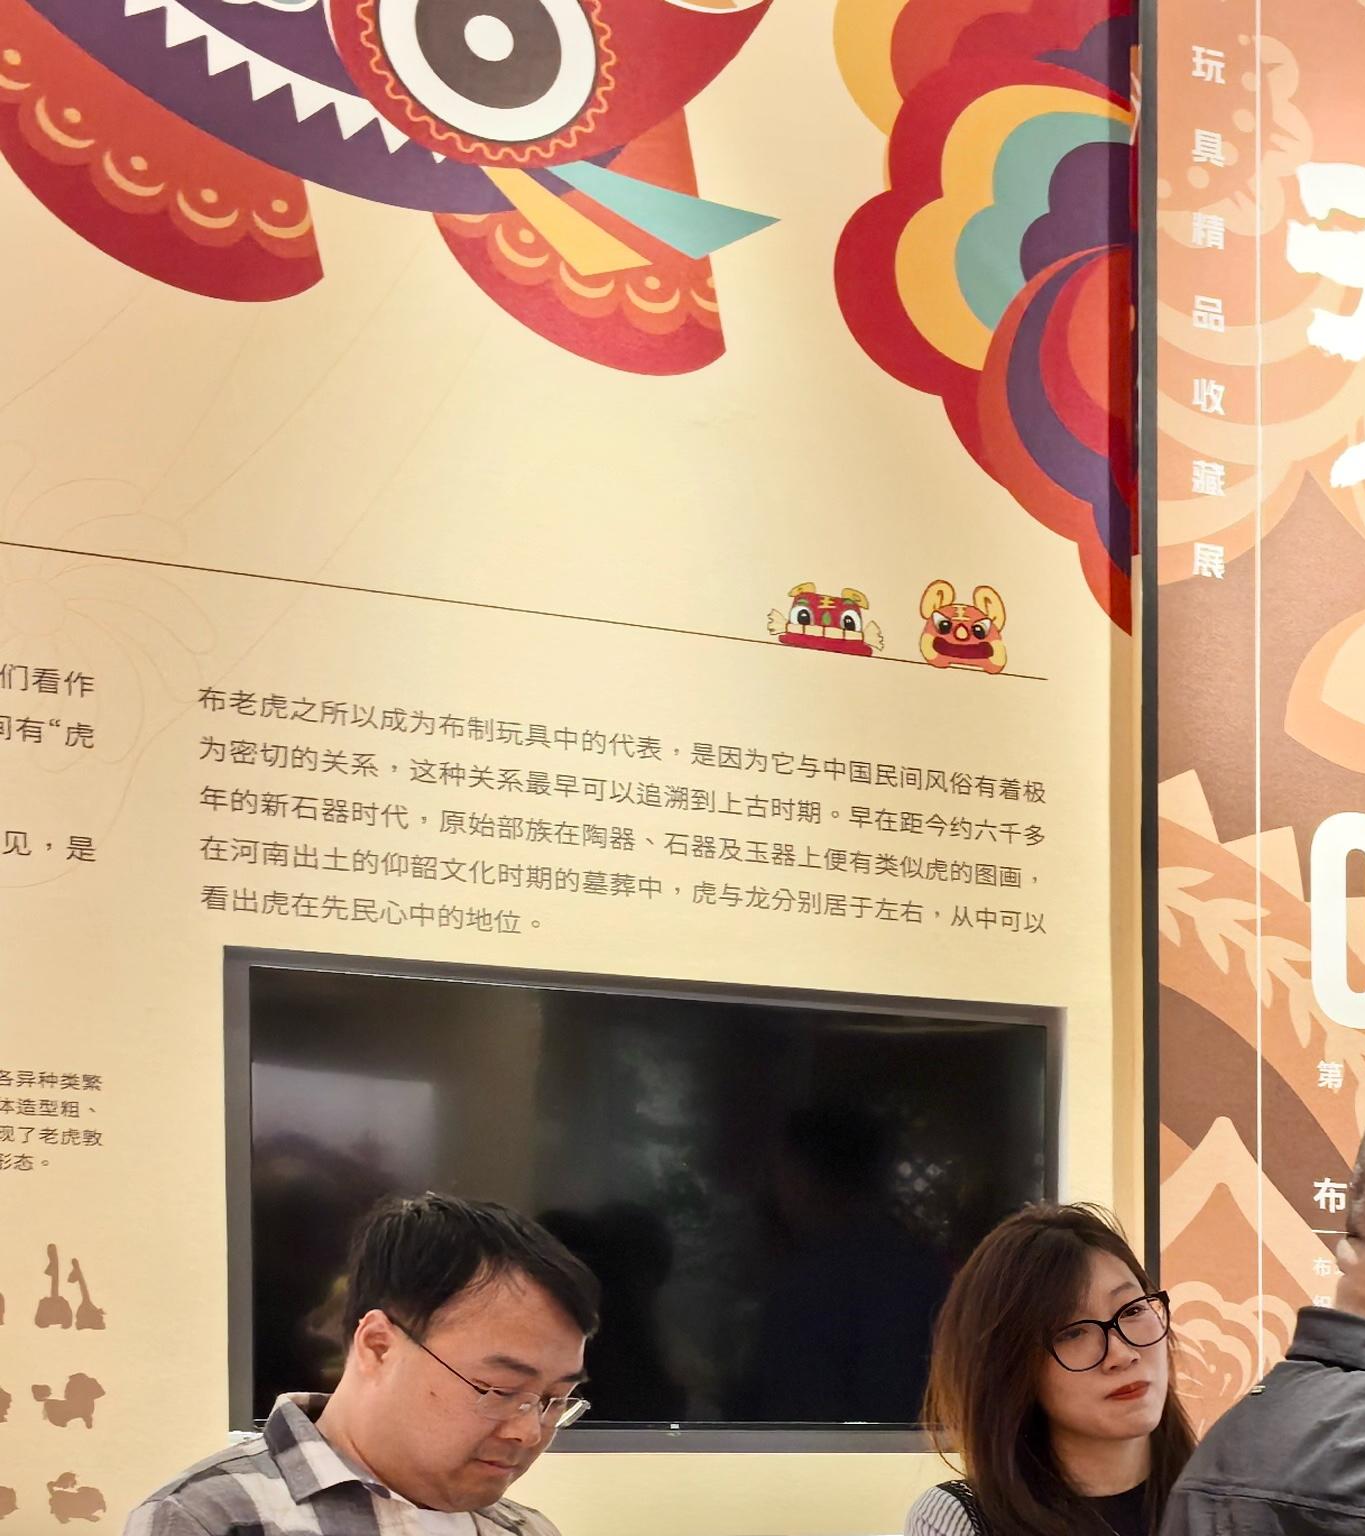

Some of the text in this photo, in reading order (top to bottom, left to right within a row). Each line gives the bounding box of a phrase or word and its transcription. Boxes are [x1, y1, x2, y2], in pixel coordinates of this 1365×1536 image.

[1191, 45, 1226, 581] 玩具精品收藏展
[0, 663, 95, 698] 们看作
[199, 686, 1047, 805] 布老虎之所以成为布制玩具中的代表，是因为它与中国民间风俗有着极
[199, 735, 1046, 848] 为密切的关系，这种关系最早可以追溯到上古时期。早在距今约六千多
[199, 784, 1040, 889] 年的新石器时代，原始部族在陶器、石器及玉器上便有类似虎的图画，
[200, 834, 1047, 935] 在河南出土的仰韶文化时期的墓葬中，虎与龙分别居于左右，从中可以
[200, 884, 542, 935] 看出虎在先民心中的地位。
[1313, 1177, 1353, 1214] 布
